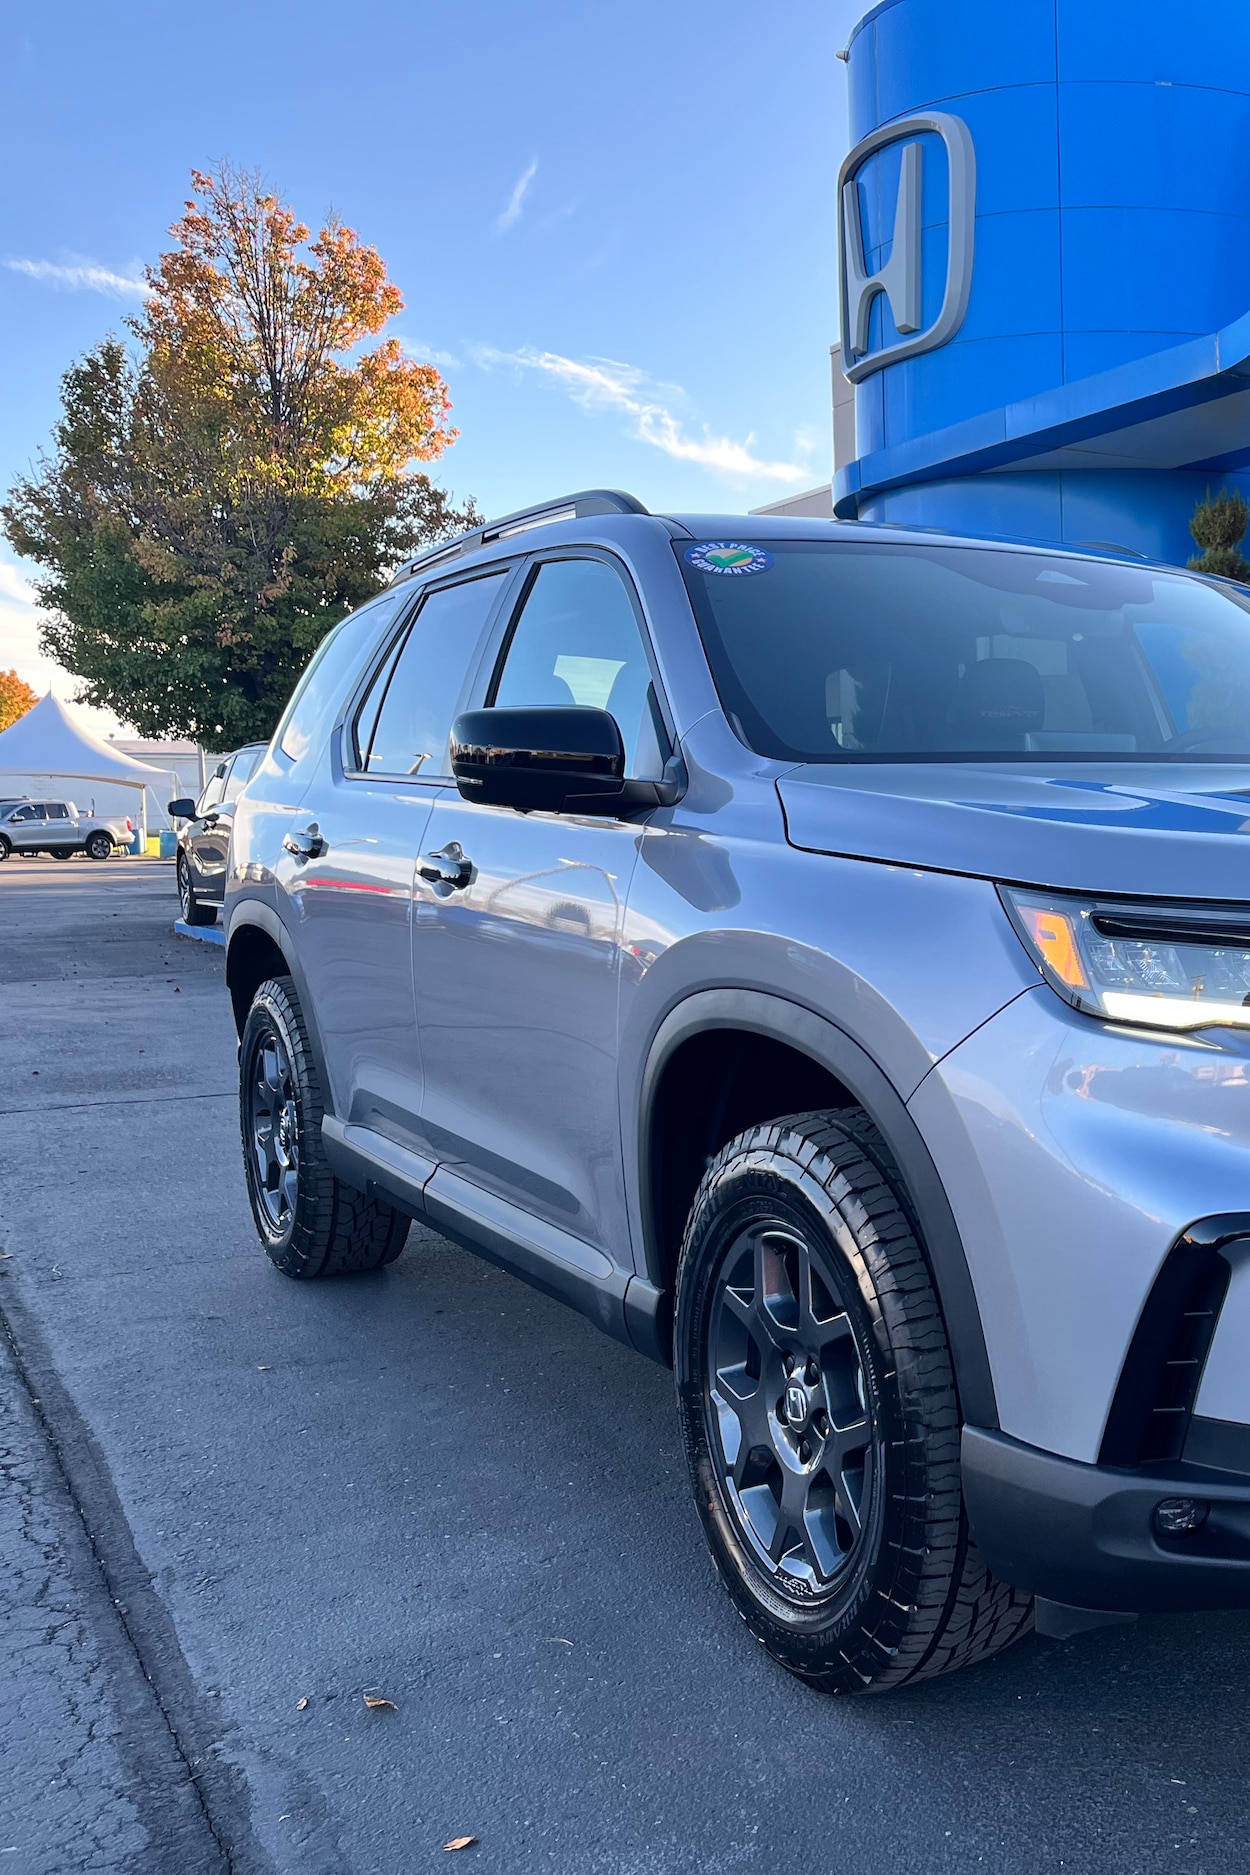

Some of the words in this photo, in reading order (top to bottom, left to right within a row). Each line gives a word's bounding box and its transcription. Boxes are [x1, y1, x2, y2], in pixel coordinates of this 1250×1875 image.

[694, 542, 725, 553] BEST
[729, 543, 766, 557] PRICE
[691, 558, 765, 574] GUARANTEE
